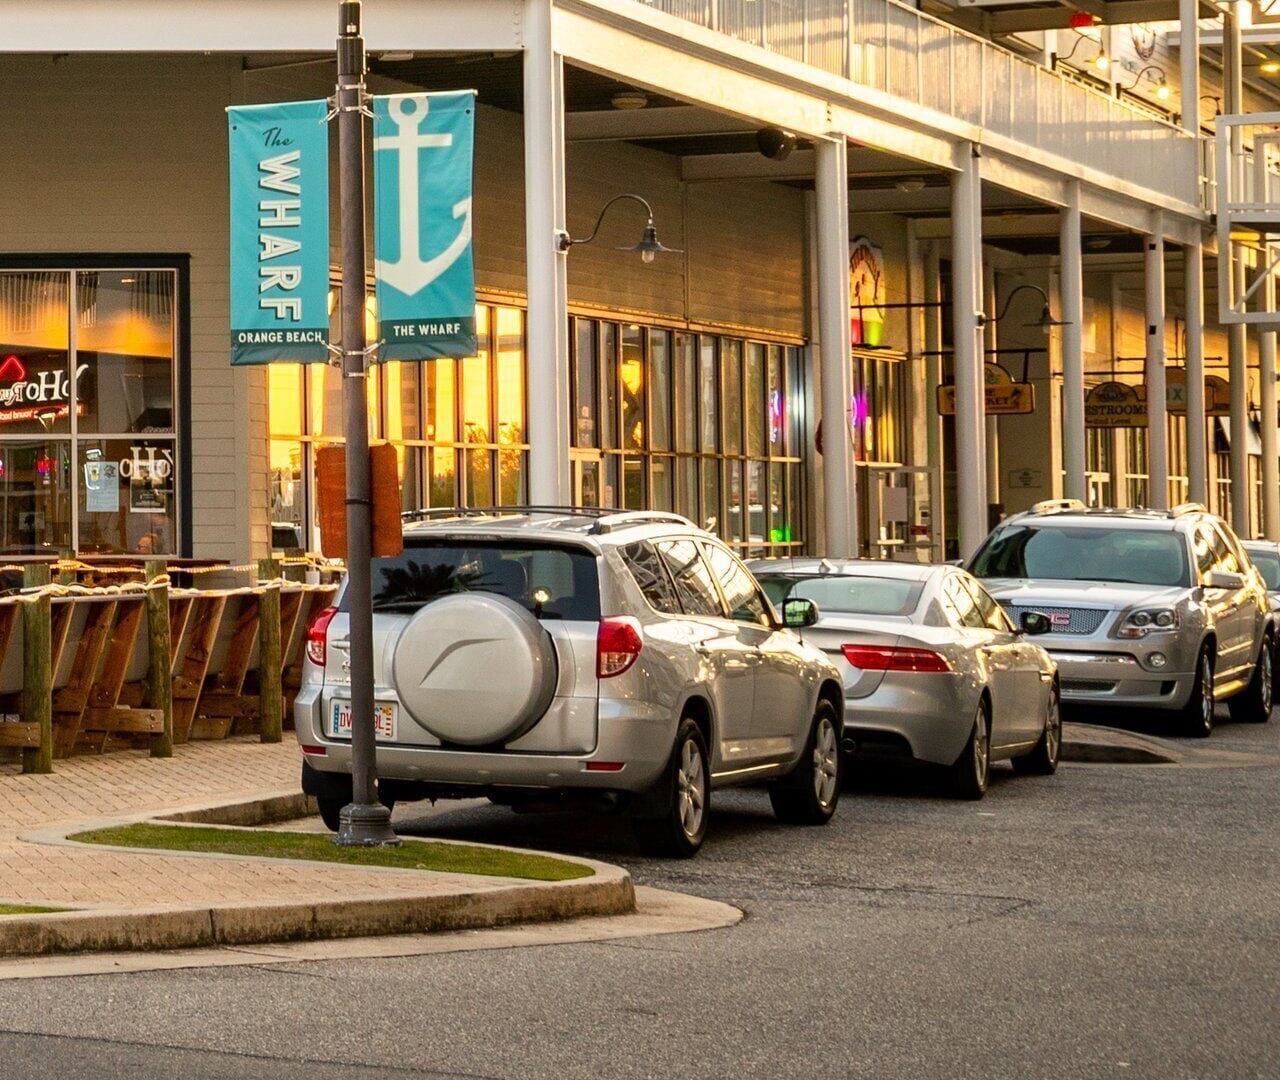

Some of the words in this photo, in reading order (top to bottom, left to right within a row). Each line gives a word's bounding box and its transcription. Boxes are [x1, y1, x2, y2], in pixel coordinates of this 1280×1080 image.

[262, 126, 295, 148] The
[258, 149, 302, 322] WHARF
[238, 331, 283, 344] ORANGE
[286, 331, 323, 344] BEACH
[393, 324, 415, 337] THE
[419, 322, 461, 337] WHARF
